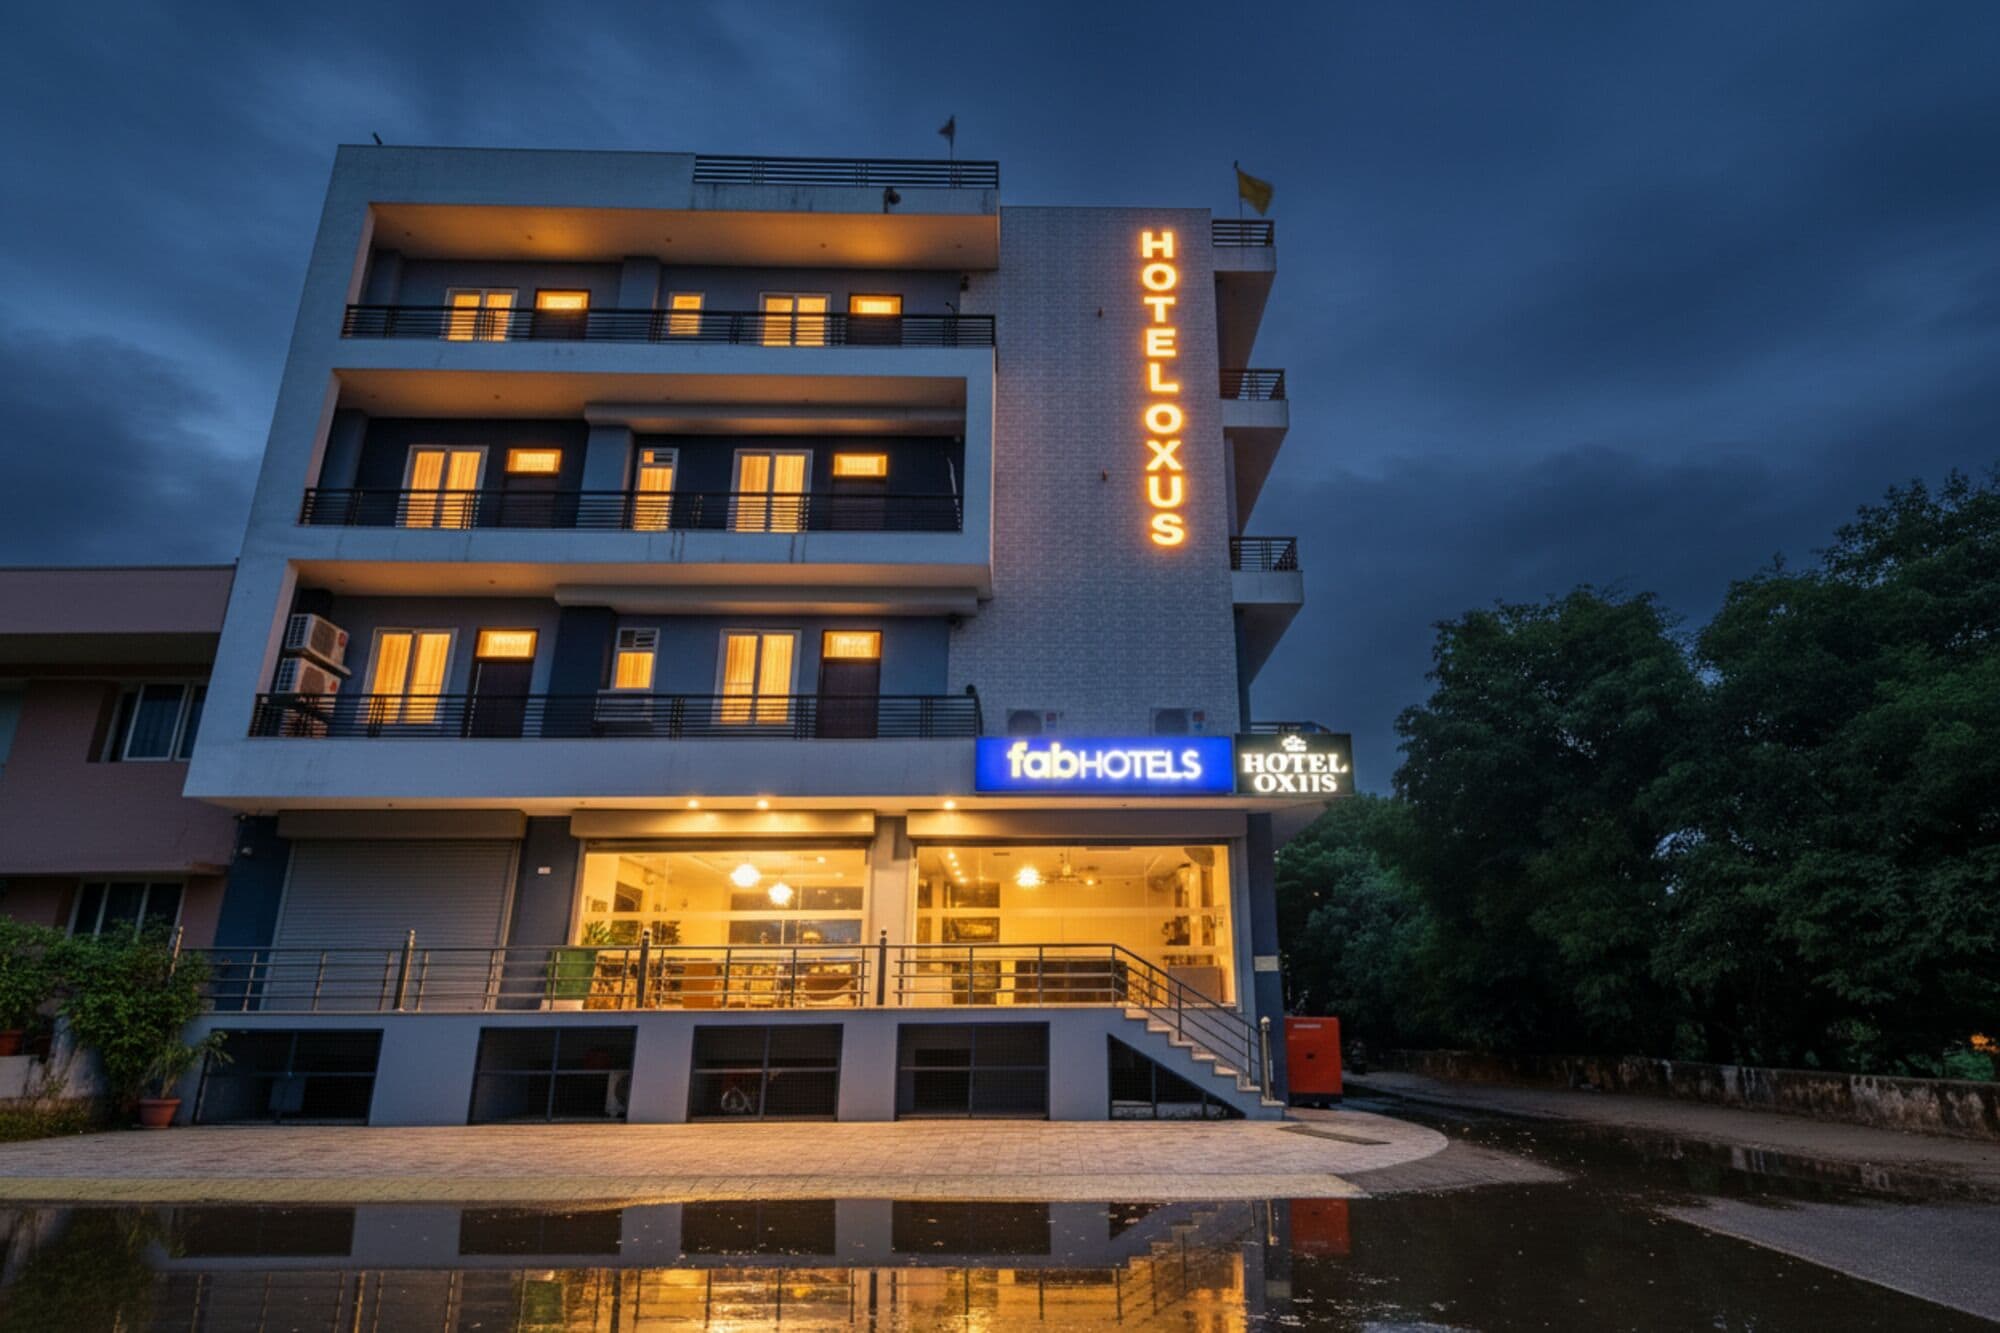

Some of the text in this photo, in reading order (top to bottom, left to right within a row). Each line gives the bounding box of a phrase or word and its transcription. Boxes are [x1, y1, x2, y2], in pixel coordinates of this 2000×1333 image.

[1142, 231, 1185, 546] HOTEL OXUS
[1242, 752, 1348, 773] HOTEL
